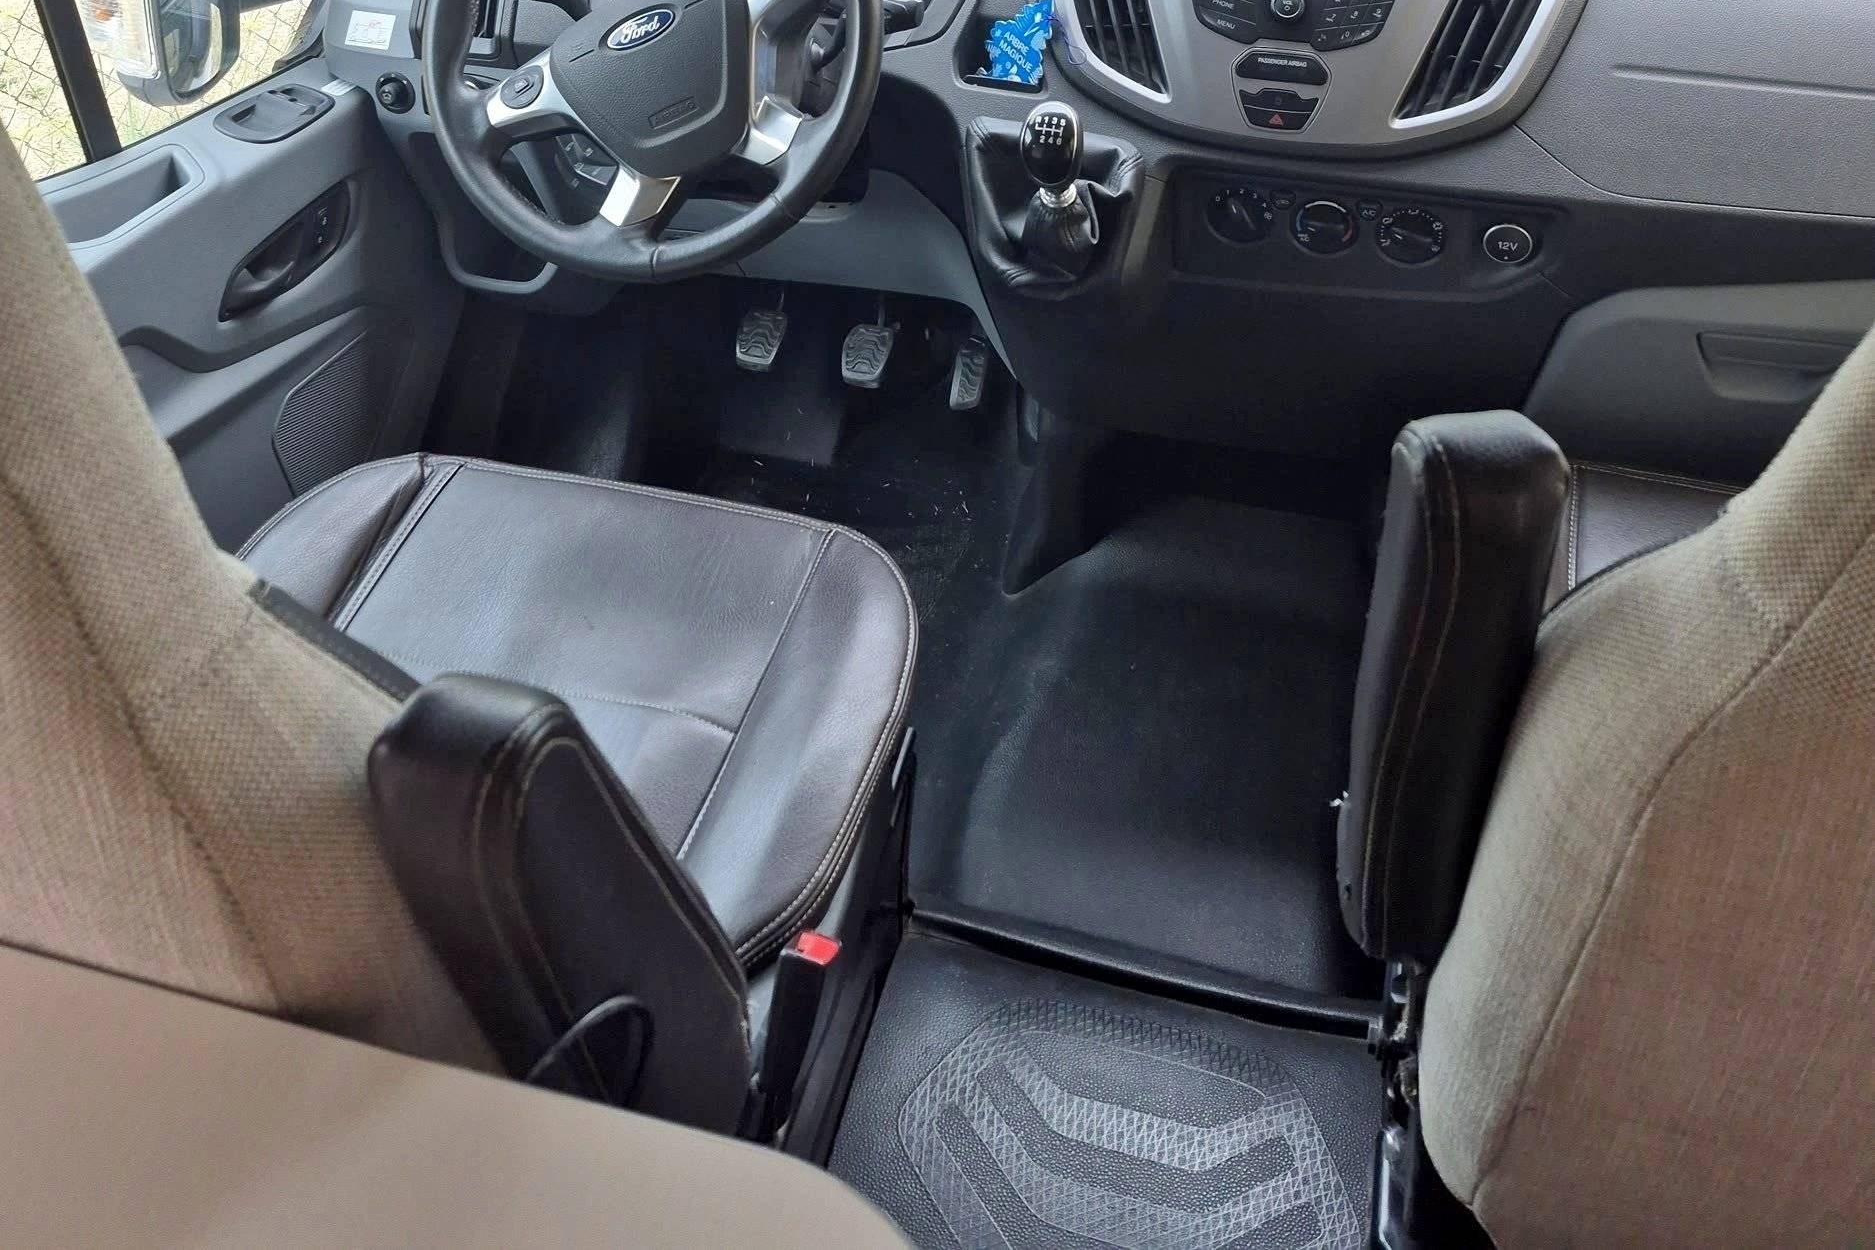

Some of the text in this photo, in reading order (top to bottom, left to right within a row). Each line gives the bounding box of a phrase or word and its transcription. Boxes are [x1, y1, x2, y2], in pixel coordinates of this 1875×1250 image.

[620, 15, 661, 44] Ford
[1216, 19, 1236, 30] MENU
[1004, 31, 1030, 56] ARBRE
[998, 39, 1034, 73] MAGIQUE
[1258, 57, 1307, 68] PASSENGER AIRBAG
[1497, 241, 1519, 251] 12V
